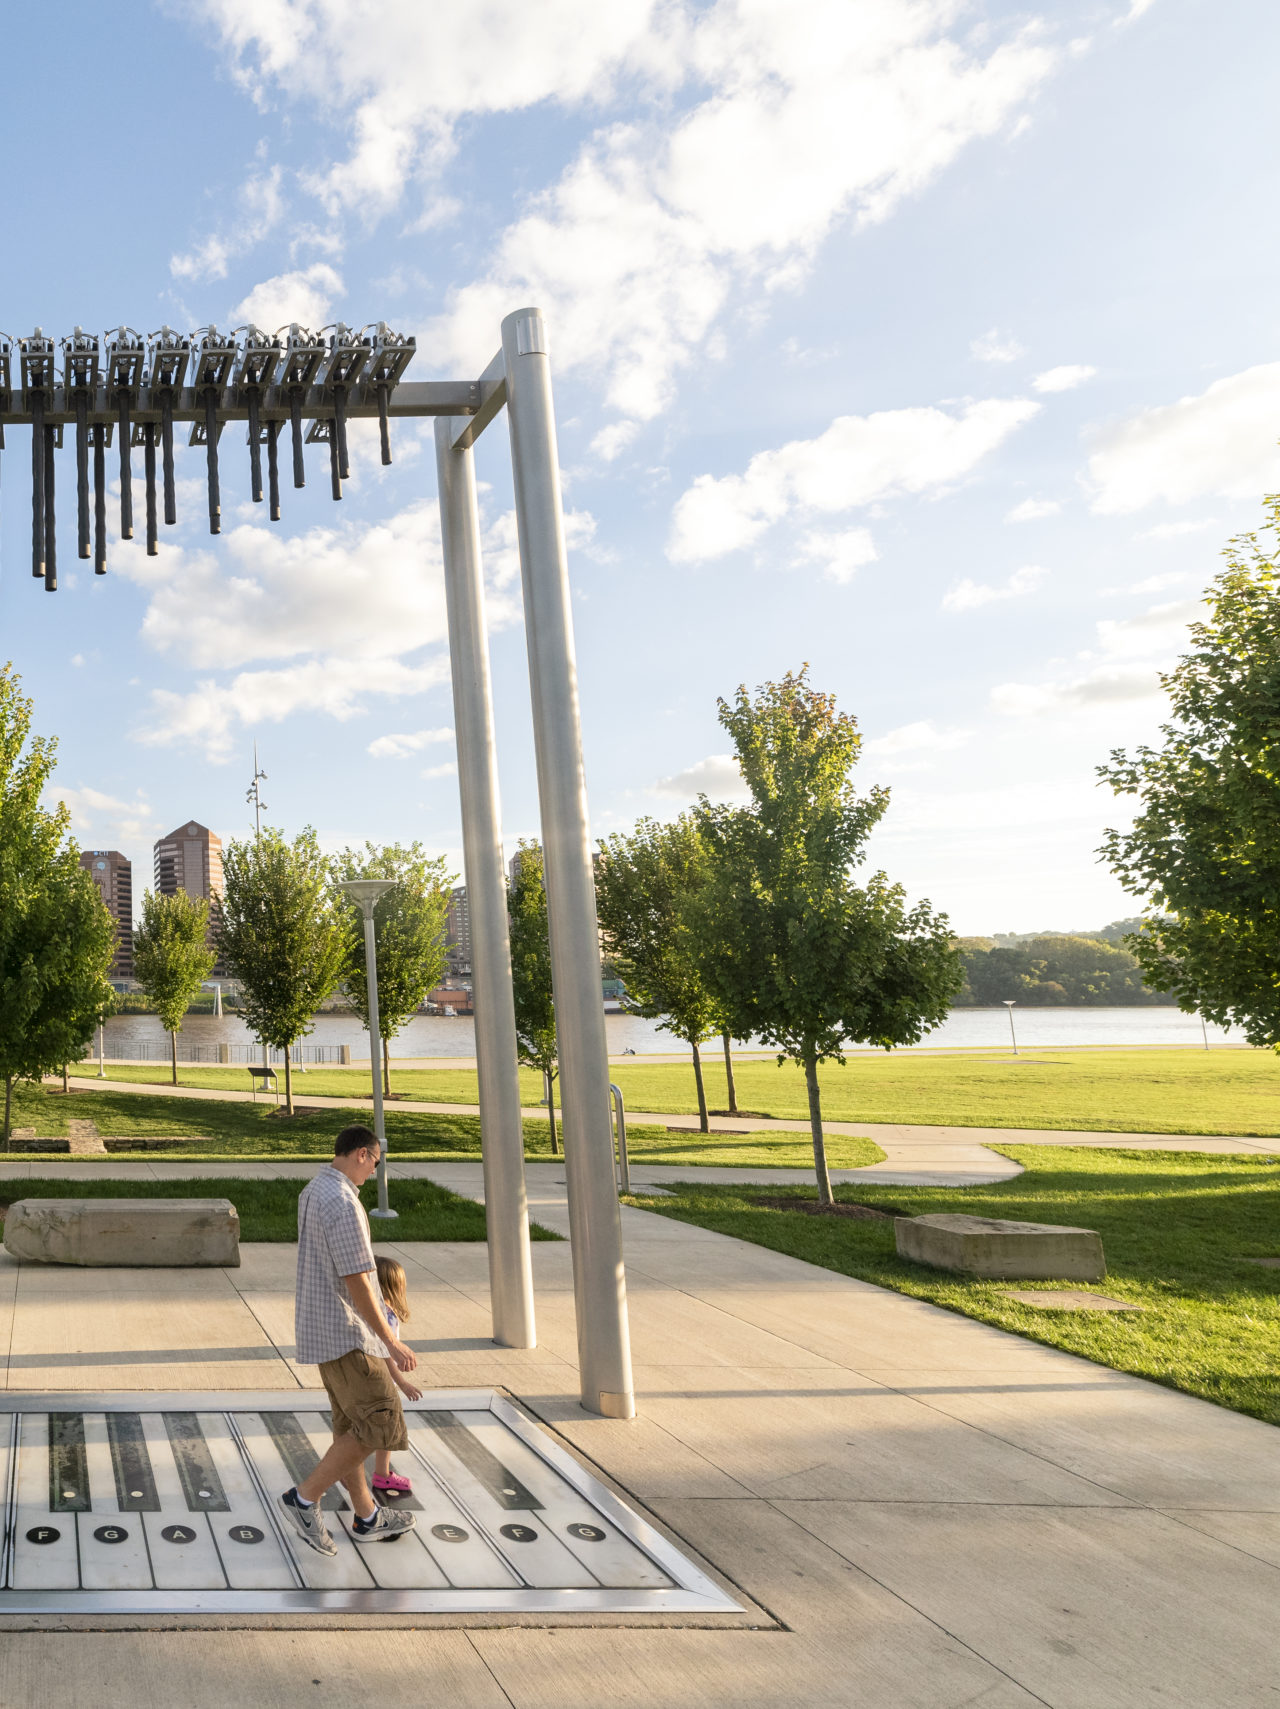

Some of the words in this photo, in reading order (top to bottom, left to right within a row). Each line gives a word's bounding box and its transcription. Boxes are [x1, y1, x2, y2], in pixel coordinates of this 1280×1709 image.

[38, 1532, 49, 1540] F
[103, 1531, 119, 1539] G
[172, 1531, 187, 1539] A
[239, 1531, 254, 1539] B
[442, 1530, 459, 1538] E
[511, 1529, 524, 1538] F
[578, 1528, 596, 1537] G
